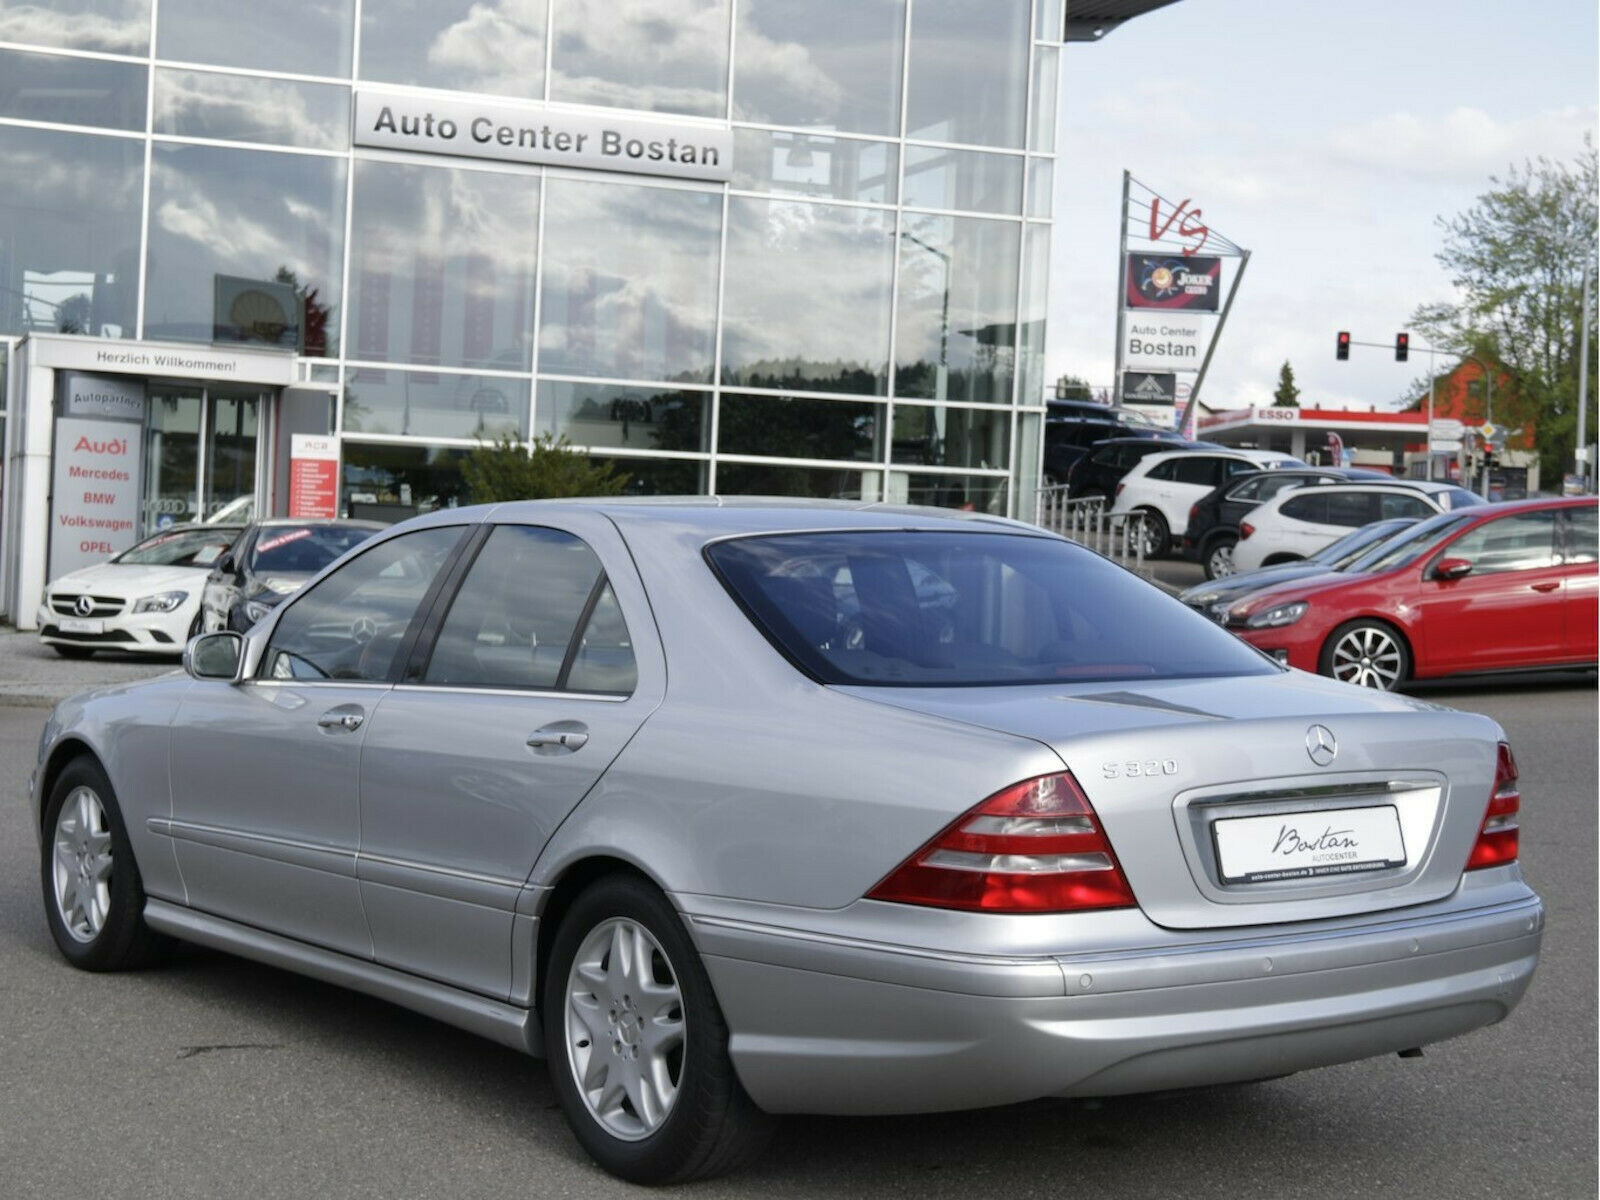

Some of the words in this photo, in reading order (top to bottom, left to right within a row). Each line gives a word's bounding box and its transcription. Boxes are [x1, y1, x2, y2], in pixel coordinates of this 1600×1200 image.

[373, 106, 458, 140] Auto
[470, 117, 589, 153] Center
[600, 130, 720, 167] Bostan
[1149, 198, 1208, 258] VS
[1131, 325, 1157, 336] Auto
[1160, 326, 1197, 337] Center
[1129, 339, 1197, 357] Bostan
[96, 350, 150, 366] Herzlich
[154, 355, 237, 373] Willkommen!
[73, 392, 145, 410] Autopartner
[1258, 409, 1294, 421] ESSO
[74, 435, 128, 456] Audi
[69, 465, 130, 481] Mercedes
[83, 491, 116, 505] BMW
[60, 514, 133, 532] Volkswagen
[80, 541, 113, 554] OPEL
[1103, 763, 1119, 779] S
[1125, 760, 1179, 778] 320
[1271, 824, 1360, 856] Bostan
[1312, 851, 1359, 863] AUTOCENTER
